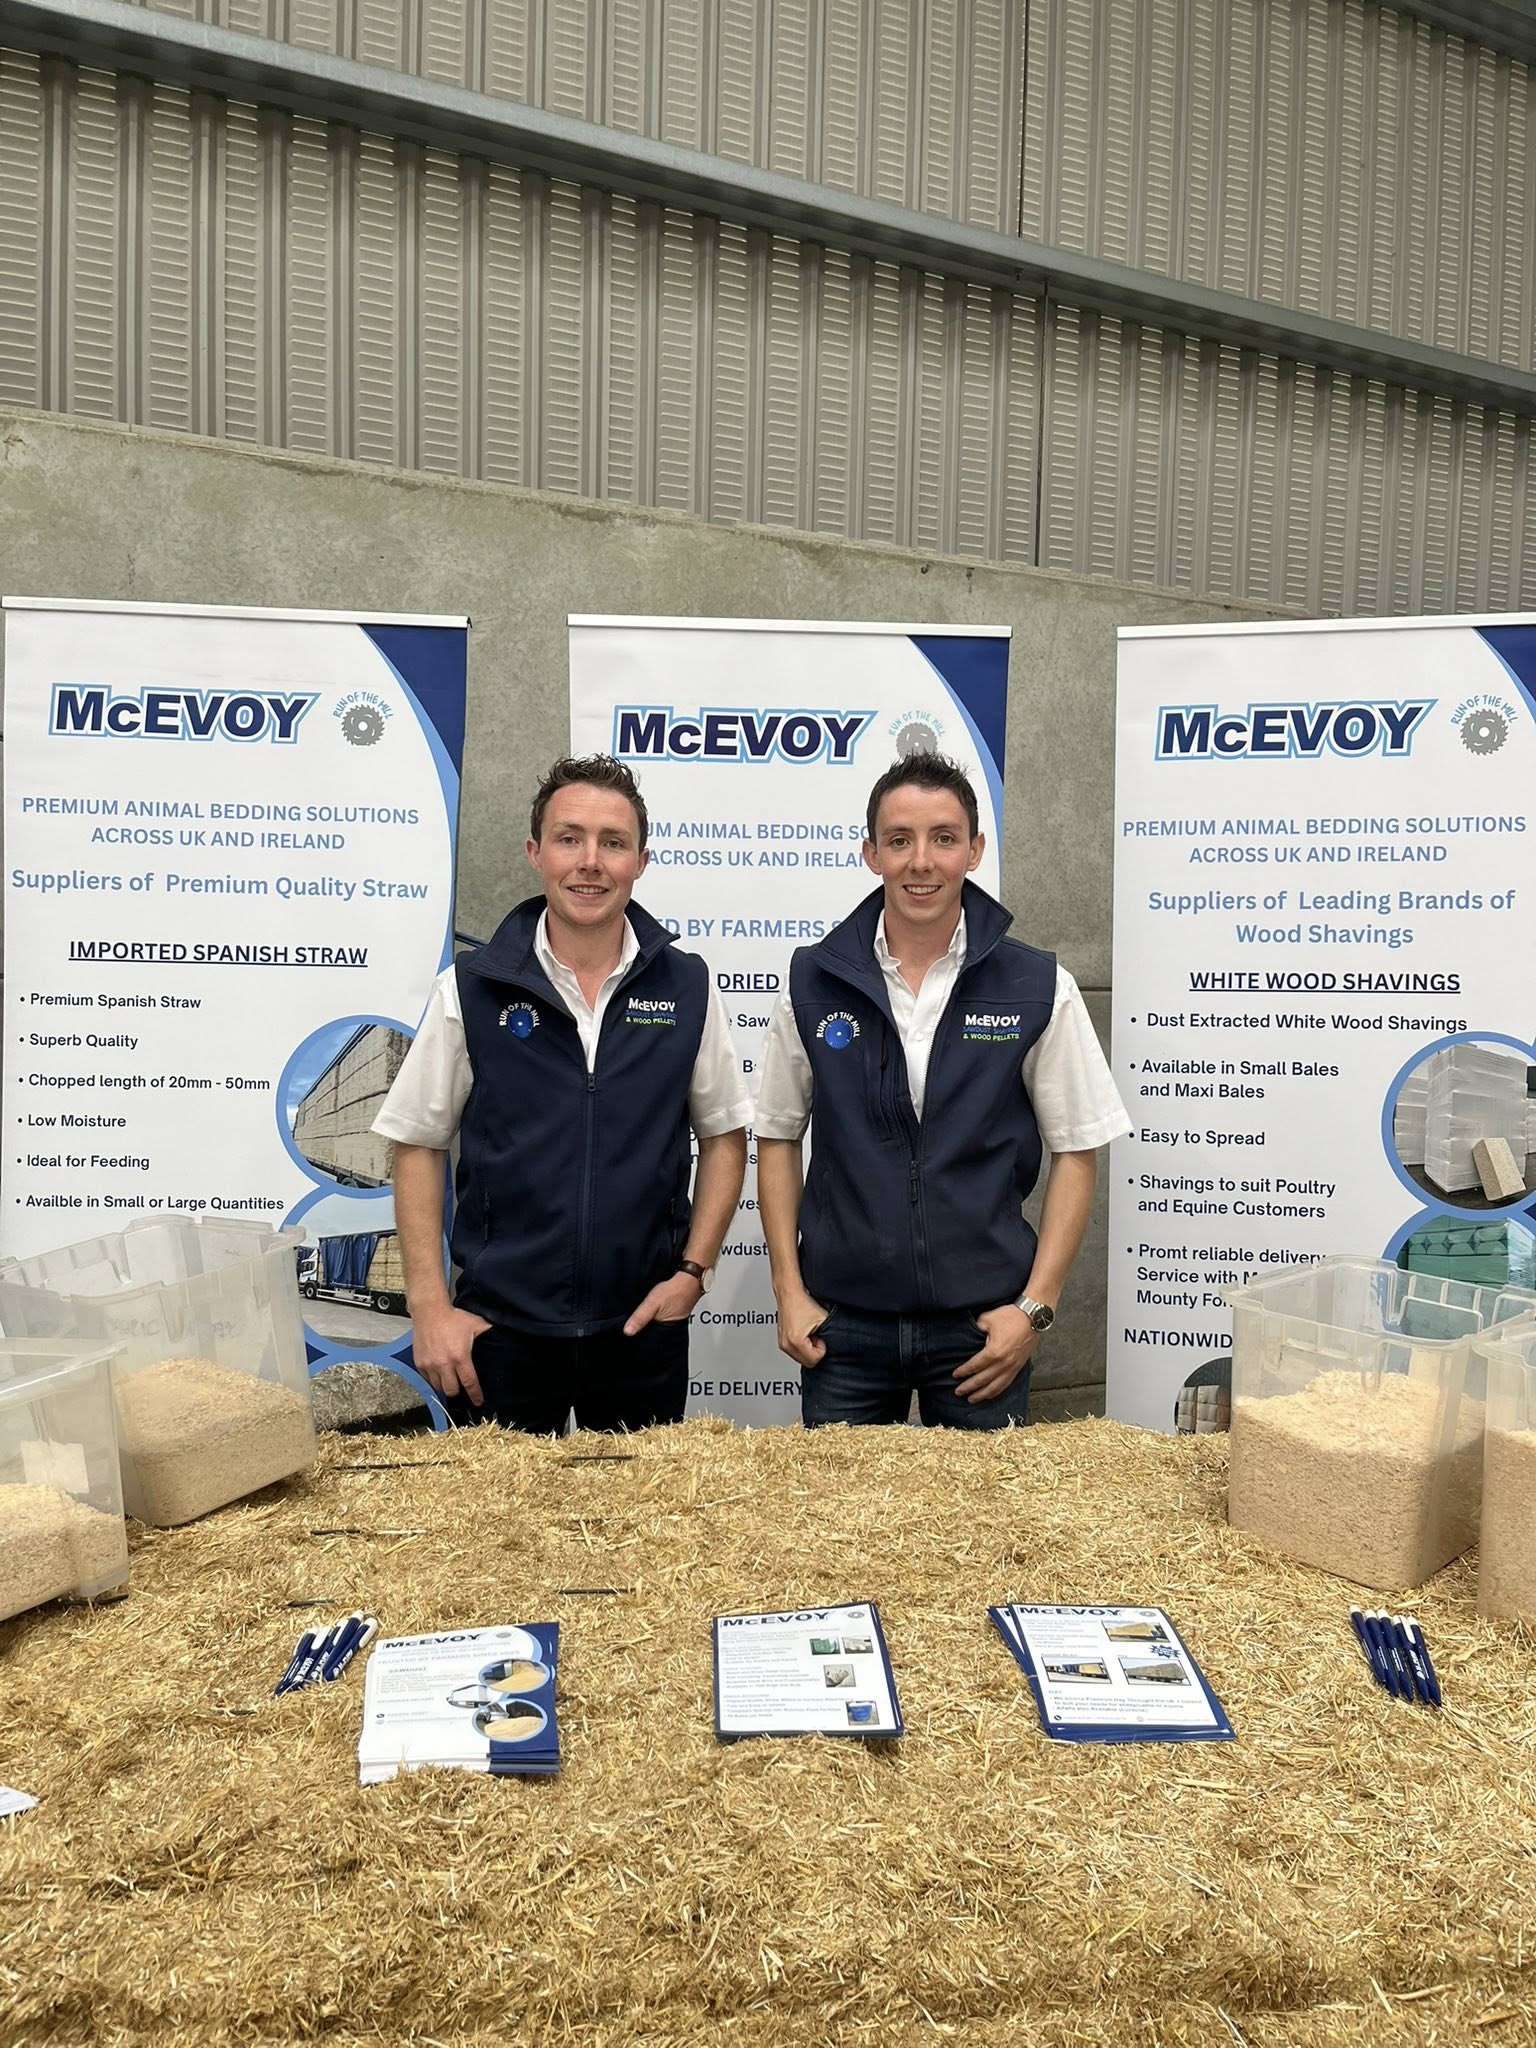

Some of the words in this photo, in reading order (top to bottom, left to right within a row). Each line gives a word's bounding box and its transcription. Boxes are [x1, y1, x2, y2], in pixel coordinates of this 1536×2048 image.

[49, 682, 321, 744] McEVOY
[332, 698, 348, 718] RUN
[347, 691, 359, 703] OF
[361, 691, 379, 704] THE
[378, 700, 394, 719] MILL
[1450, 703, 1468, 724] RUN
[1466, 695, 1480, 708] OF
[1482, 694, 1502, 707] THE
[1500, 702, 1518, 723] MILL
[612, 706, 877, 765] McEVOY
[1154, 699, 1438, 761] McEVOY
[22, 797, 119, 816] PREMIUM
[124, 800, 205, 819] ANIMAL
[210, 803, 301, 822] BEDDING
[306, 806, 419, 825] SOLUTIONS
[676, 822, 752, 840] ANIMAL
[757, 823, 843, 841] BEDDING
[1123, 819, 1216, 837] PREMIUM
[1221, 819, 1301, 835] ANIMAL
[1306, 817, 1400, 835] BEDDING
[1405, 816, 1526, 834] SOLUTIONS
[91, 827, 174, 846] ACROSS
[179, 830, 206, 846] UK
[210, 831, 255, 847] AND
[260, 832, 345, 850] IRELAND
[648, 849, 723, 866] ACROSS
[728, 850, 754, 867] UK
[757, 851, 800, 867] AND
[803, 851, 863, 869] IRELA
[1188, 847, 1269, 863] ACROSS
[1274, 847, 1302, 863] UK
[1306, 846, 1351, 863] AND
[1357, 845, 1447, 863] IRELAND
[11, 869, 123, 894] Suppliers
[129, 872, 155, 892] of
[166, 873, 268, 895] Premium
[275, 876, 357, 902] Quality
[362, 878, 429, 899] Straw
[1148, 890, 1257, 915] Suppliers
[1263, 890, 1288, 910] of
[1299, 890, 1392, 915] Leading
[1398, 889, 1483, 910] Brands
[1490, 889, 1516, 910] of
[687, 919, 716, 937] BY
[721, 918, 825, 939] FARMERS
[1235, 923, 1302, 944] Wood
[1308, 923, 1414, 949] Shavings
[69, 938, 188, 961] IMPORTED
[192, 943, 290, 964] SPANISH
[294, 946, 368, 966] STRAW
[716, 973, 780, 990] DRIED
[1190, 971, 1260, 989] WHITE
[1265, 972, 1337, 991] WOOD
[1342, 972, 1461, 992] SHAVINGS
[30, 992, 94, 1007] Premium
[97, 994, 157, 1010] Spanish
[160, 995, 202, 1009] Straw
[628, 997, 676, 1012] McEVOY
[499, 1008, 510, 1026] RUN
[507, 1002, 520, 1011] OF
[965, 1013, 1021, 1028] McEVOY
[1147, 1012, 1185, 1027] Dust
[1190, 1013, 1270, 1028] Extracted
[1275, 1013, 1326, 1029] White
[1331, 1014, 1383, 1030] Wood
[1387, 1013, 1468, 1034] Shavings
[816, 1019, 828, 1038] RUN
[827, 1012, 839, 1021] OF
[839, 1011, 854, 1022] THE
[850, 1020, 861, 1038] MILL
[29, 1032, 82, 1049] Superb
[85, 1034, 139, 1050] Quality
[970, 1033, 991, 1041] WOOD
[1141, 1058, 1217, 1075] Available
[1221, 1060, 1235, 1075] in
[1239, 1060, 1287, 1076] Small
[1292, 1061, 1339, 1077] Bales
[28, 1073, 96, 1090] Chopped
[99, 1074, 146, 1091] length
[150, 1075, 165, 1088] of
[168, 1075, 212, 1089] 20mm
[225, 1077, 270, 1090] 50mm
[1139, 1082, 1170, 1097] and
[1175, 1083, 1214, 1098] Maxi
[1218, 1083, 1265, 1099] Bales
[28, 1113, 57, 1127] Low
[60, 1114, 127, 1128] Moisture
[1141, 1128, 1180, 1147] Easy
[1183, 1129, 1201, 1144] to
[1205, 1130, 1265, 1148] Spread
[27, 1154, 62, 1167] Ideal
[65, 1154, 87, 1168] for
[90, 1155, 150, 1171] Feeding
[1139, 1174, 1214, 1194] Shavings
[1218, 1177, 1236, 1192] to
[1240, 1178, 1271, 1193] suit
[1275, 1178, 1336, 1198] Poultry
[25, 1194, 83, 1208] Availble
[86, 1195, 100, 1208] in
[103, 1195, 145, 1208] Small
[148, 1198, 164, 1208] or
[167, 1195, 207, 1212] Large
[210, 1196, 285, 1211] Quantities
[1138, 1198, 1168, 1213] and
[1173, 1199, 1229, 1217] Equine
[1232, 1200, 1326, 1219] Customers
[721, 1242, 768, 1256] wdust
[1139, 1243, 1188, 1260] Promt
[1192, 1246, 1255, 1262] reliable
[1136, 1266, 1200, 1283] Service
[1202, 1267, 1240, 1285] with
[1136, 1289, 1198, 1310] Mounty
[1124, 1327, 1234, 1349] NATIONWID
[719, 1380, 803, 1397] DELIVERY
[720, 1611, 831, 1628] McEVOY
[1018, 1606, 1123, 1617] McEVOY
